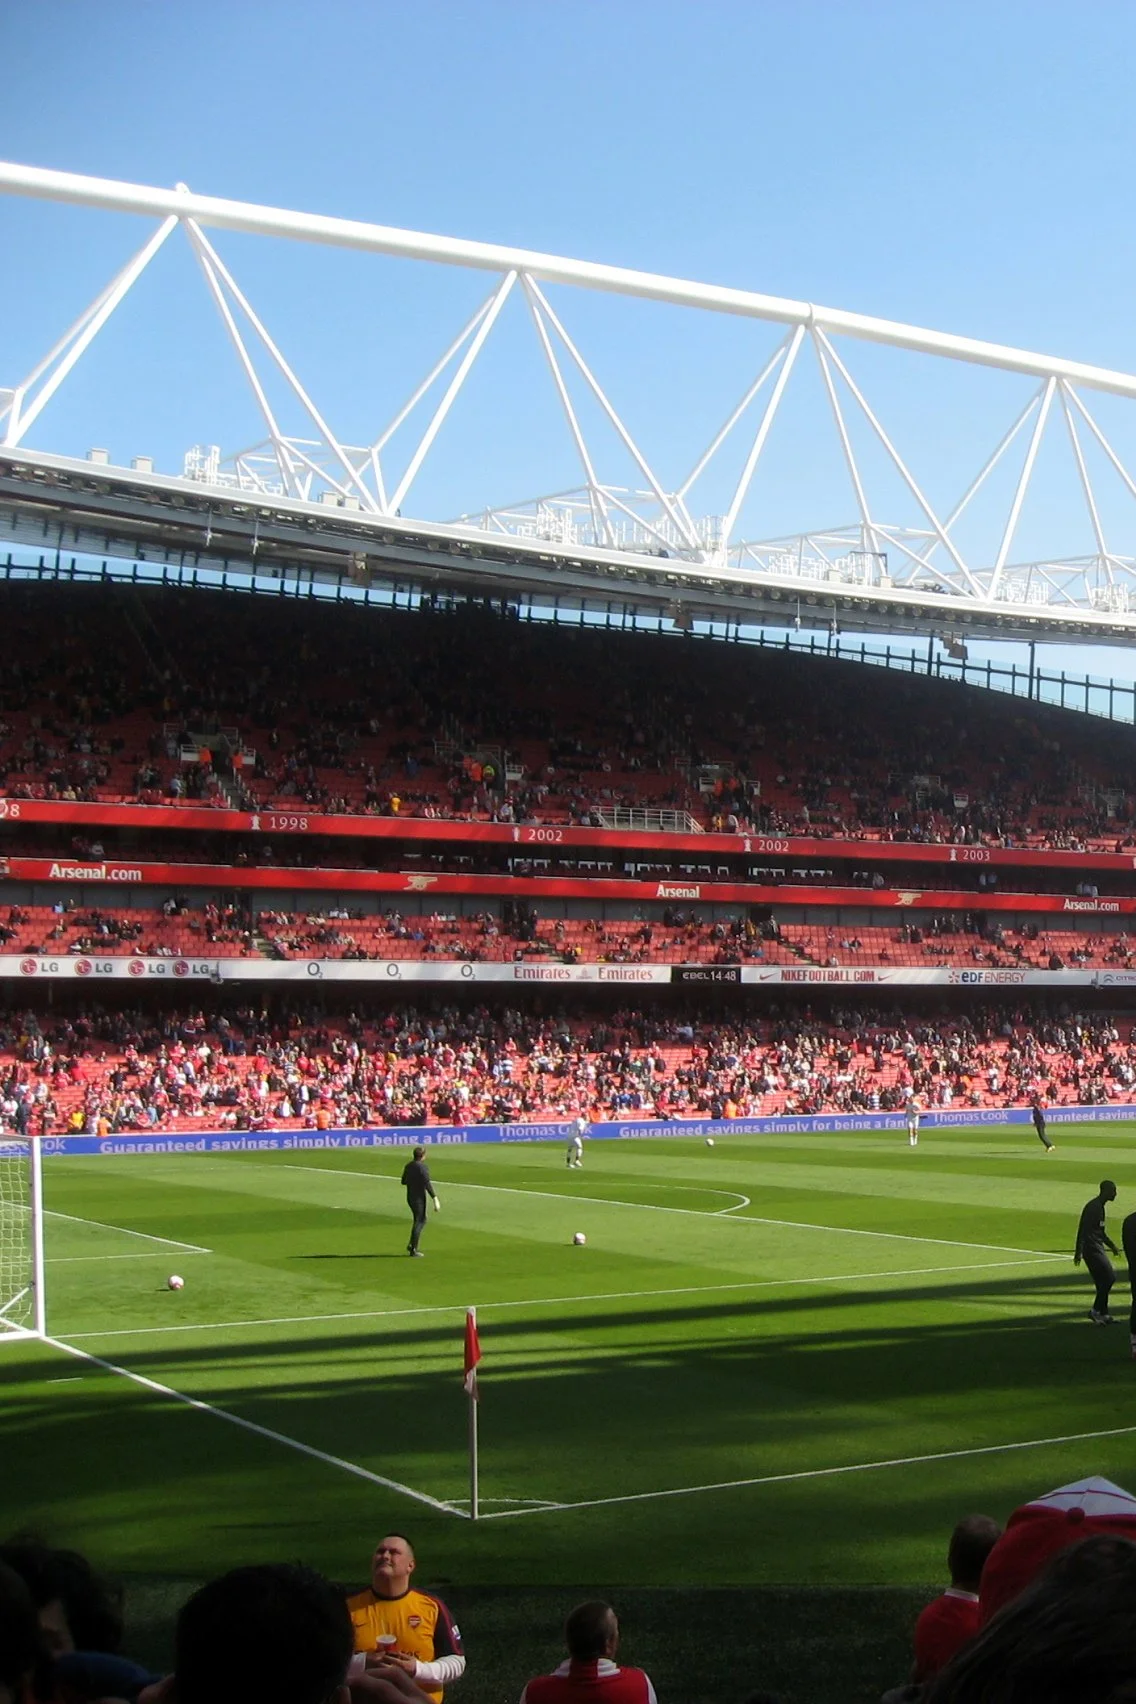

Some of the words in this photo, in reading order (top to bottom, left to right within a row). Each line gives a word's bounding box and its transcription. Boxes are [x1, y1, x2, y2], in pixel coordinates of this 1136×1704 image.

[270, 816, 308, 830] 1998
[528, 828, 563, 842] 2002
[758, 839, 789, 852] 2002
[962, 849, 991, 862] 2003
[49, 863, 142, 881] Arsenal.com
[656, 884, 700, 899] Arsenal
[1063, 898, 1120, 912] Arsenal.com
[41, 962, 59, 973] LG
[95, 963, 113, 973] LG
[149, 963, 165, 974] LG
[192, 963, 209, 974] LG
[514, 966, 571, 979] Emirates
[598, 966, 653, 981] Emirates
[781, 970, 875, 982] NIKEFOOTBALL.COM
[934, 1112, 980, 1122] Thomas
[981, 1110, 1009, 1121] Cook
[498, 1125, 556, 1137] Thomas
[619, 1124, 702, 1137] Guaranteed
[706, 1122, 761, 1135] savings
[763, 1121, 809, 1133] simply
[812, 1119, 831, 1130] for
[834, 1118, 871, 1129] being
[874, 1120, 881, 1128] a
[100, 1138, 205, 1153] Guaranteed
[211, 1137, 279, 1151] savings
[283, 1135, 340, 1149] simply
[345, 1134, 368, 1146] for
[373, 1133, 419, 1145] being
[423, 1135, 432, 1143] a
[436, 1131, 468, 1143] fan!
